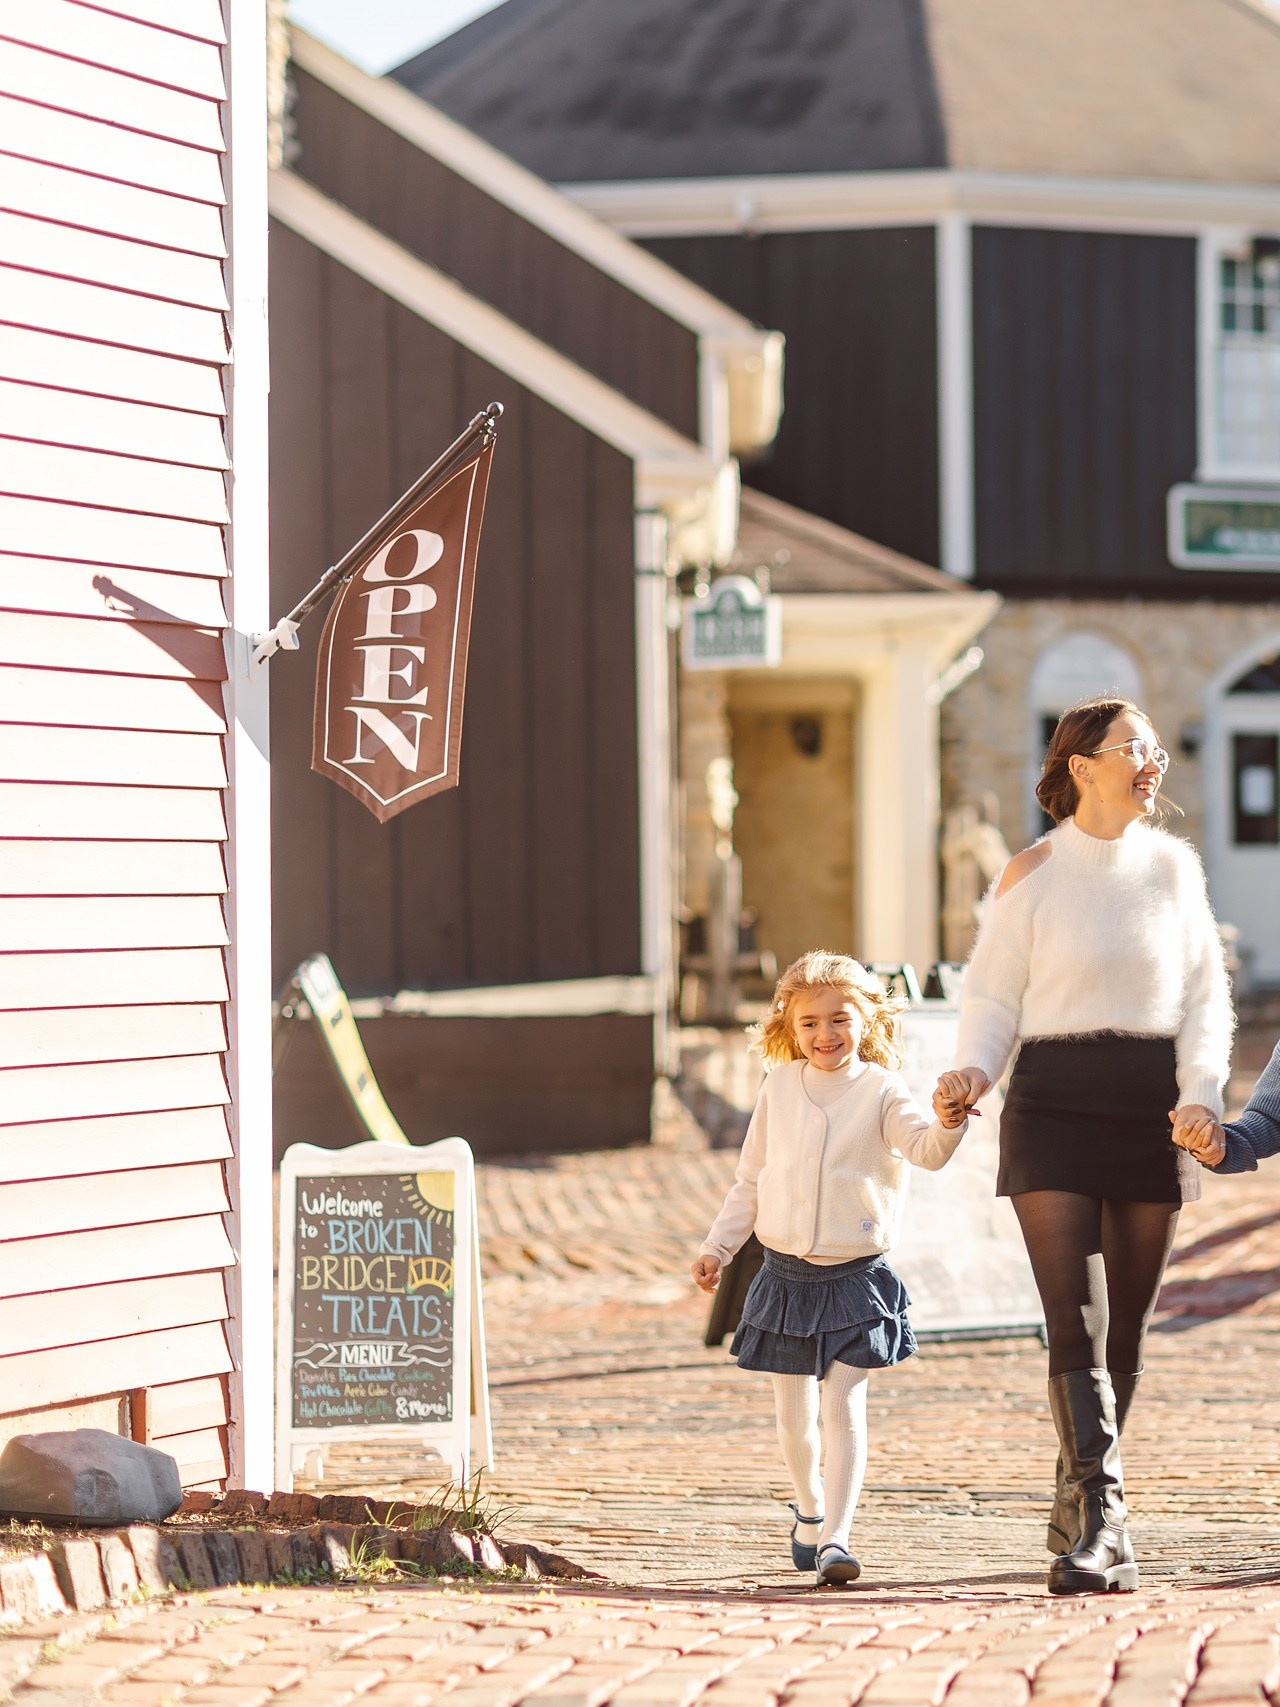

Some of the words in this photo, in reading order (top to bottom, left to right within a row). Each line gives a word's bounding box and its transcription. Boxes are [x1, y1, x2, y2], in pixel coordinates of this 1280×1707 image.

[342, 528, 445, 773] OPEN
[302, 1191, 384, 1218] Welcome
[299, 1217, 319, 1239] to
[327, 1217, 433, 1256] BROKEN
[301, 1255, 406, 1294] BRIDGE
[322, 1293, 442, 1338] TREATS
[340, 1344, 395, 1365] MENU
